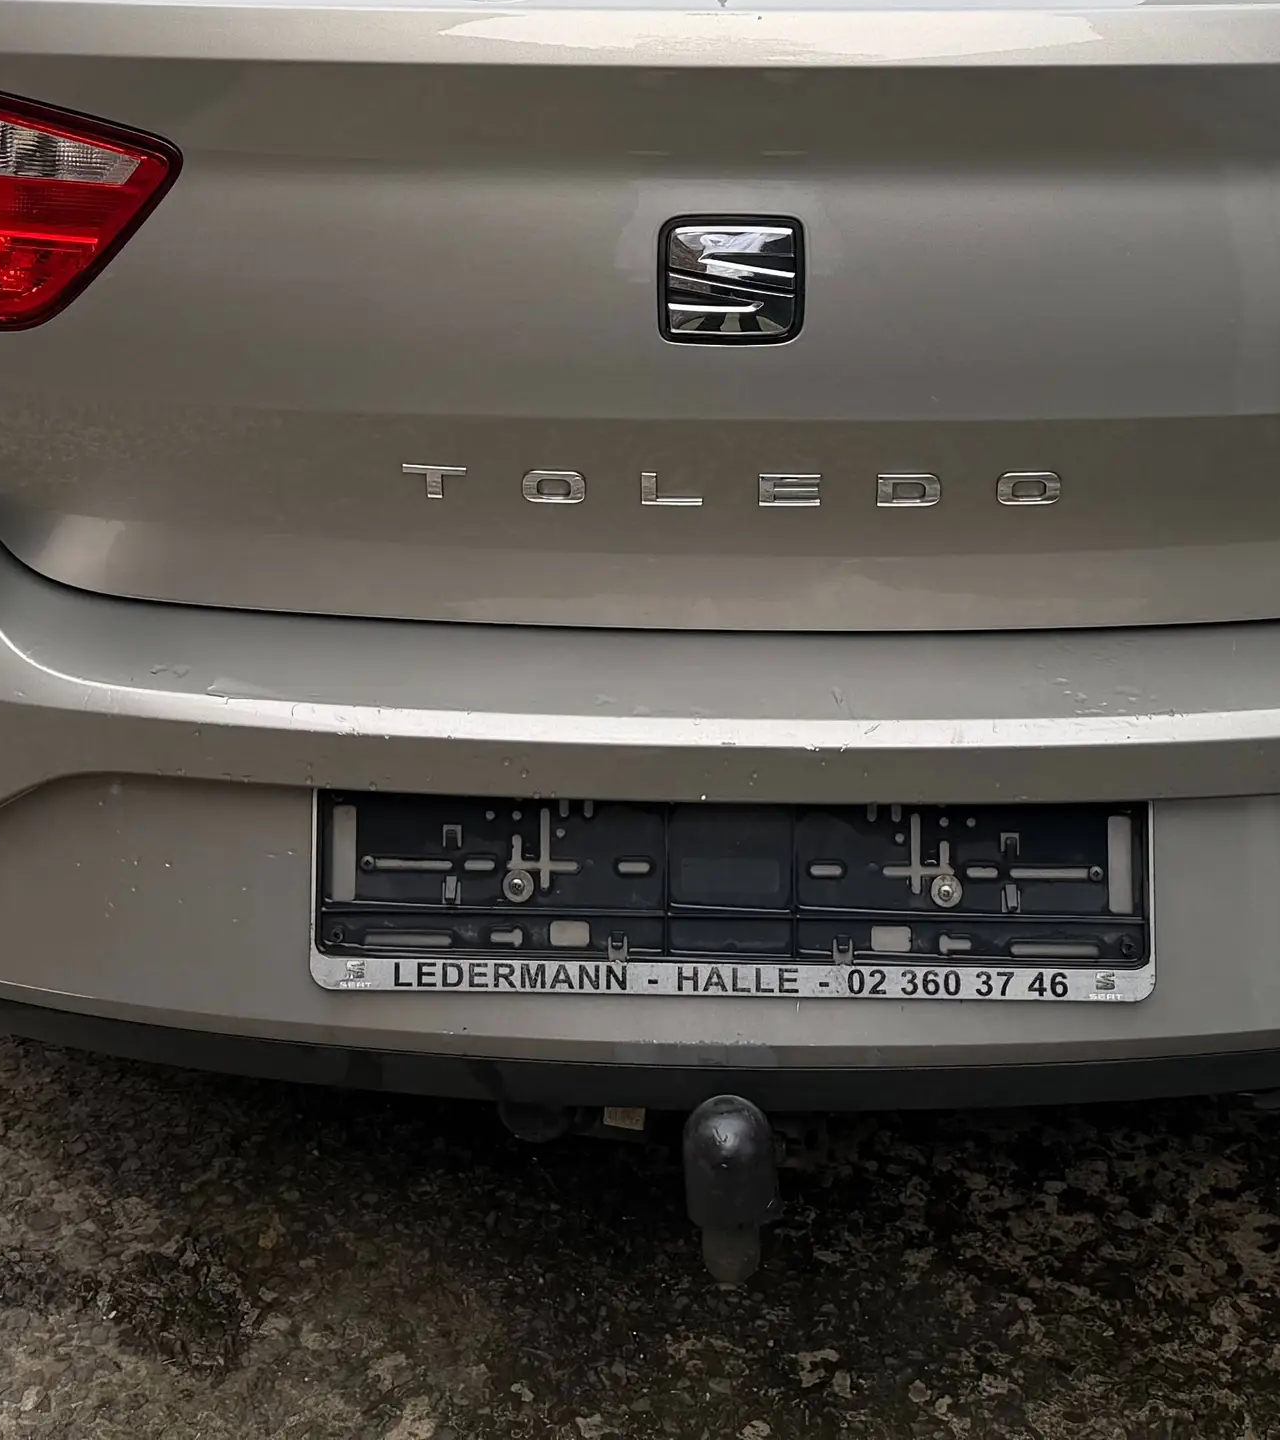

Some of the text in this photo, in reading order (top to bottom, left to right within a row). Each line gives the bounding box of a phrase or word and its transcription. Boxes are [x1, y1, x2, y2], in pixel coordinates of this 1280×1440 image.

[402, 463, 1063, 507] TOLEDO
[393, 962, 628, 991] LEDERMANN
[677, 966, 800, 993] HALLE
[847, 969, 887, 995] 02
[901, 970, 961, 996] 360
[975, 971, 1014, 997] 37
[1028, 972, 1069, 997] 46
